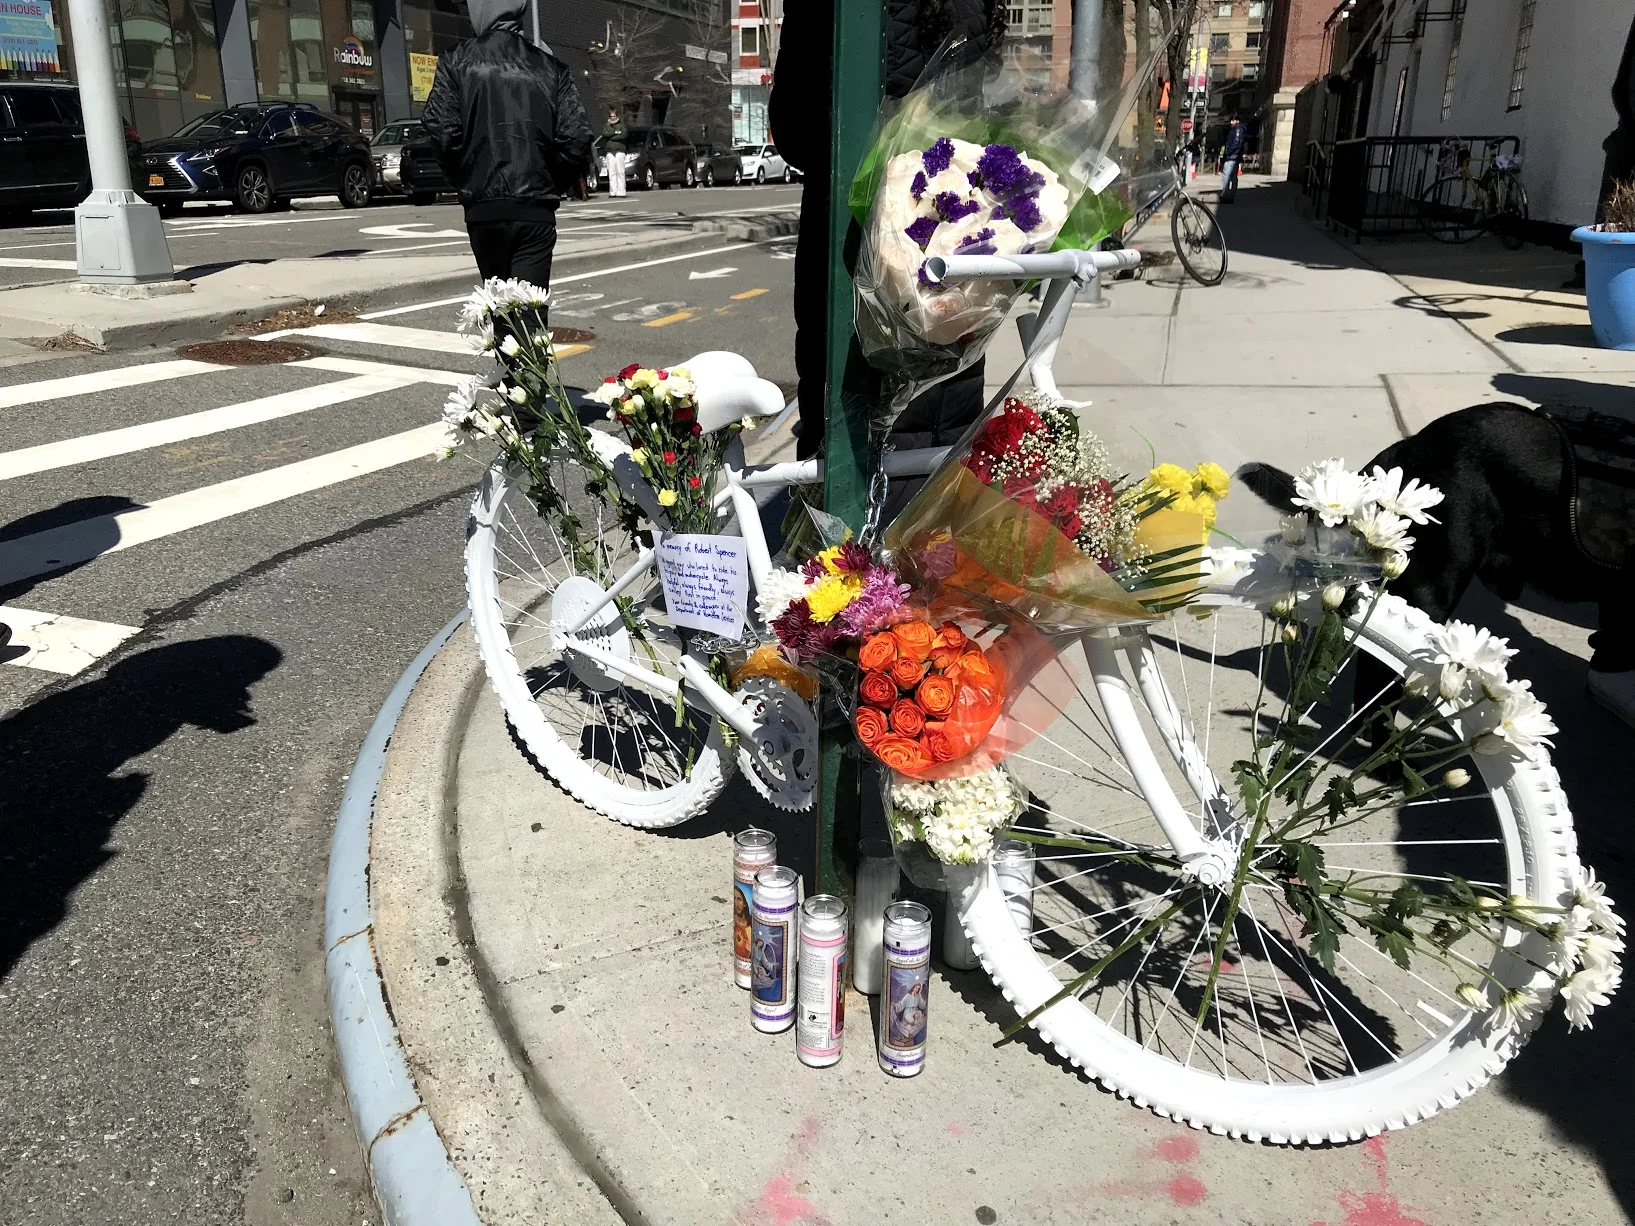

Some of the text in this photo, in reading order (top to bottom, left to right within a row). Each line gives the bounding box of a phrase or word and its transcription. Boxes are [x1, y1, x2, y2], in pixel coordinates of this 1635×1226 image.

[11, 4, 42, 16] HOUSE
[333, 47, 373, 67] Rainbow
[412, 56, 426, 65] NOW
[666, 544, 682, 555] memory
[685, 542, 691, 552] of
[694, 543, 712, 554] Robert
[715, 545, 737, 560] Spencer
[687, 560, 695, 569] who
[696, 561, 709, 571] loved
[712, 563, 717, 572] to
[718, 565, 728, 573] ride
[713, 574, 729, 587] Always
[685, 590, 695, 598] Rest
